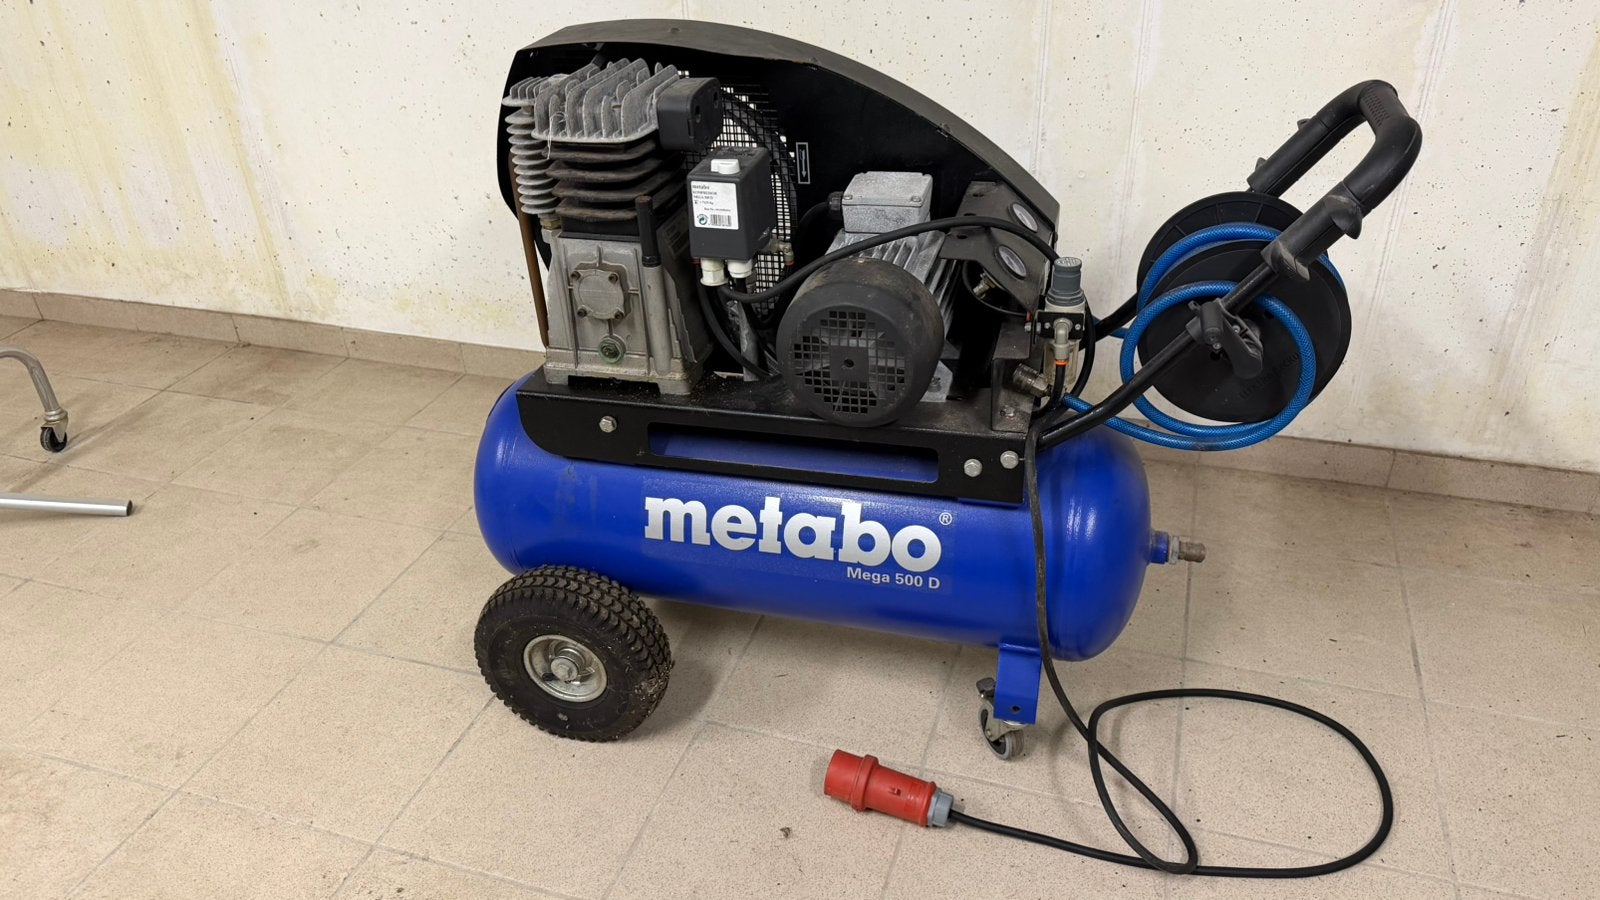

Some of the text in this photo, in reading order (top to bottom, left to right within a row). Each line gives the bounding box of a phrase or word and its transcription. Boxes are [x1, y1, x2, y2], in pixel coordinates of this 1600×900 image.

[645, 496, 942, 572] metabo
[847, 566, 940, 589] Mega 500 D
